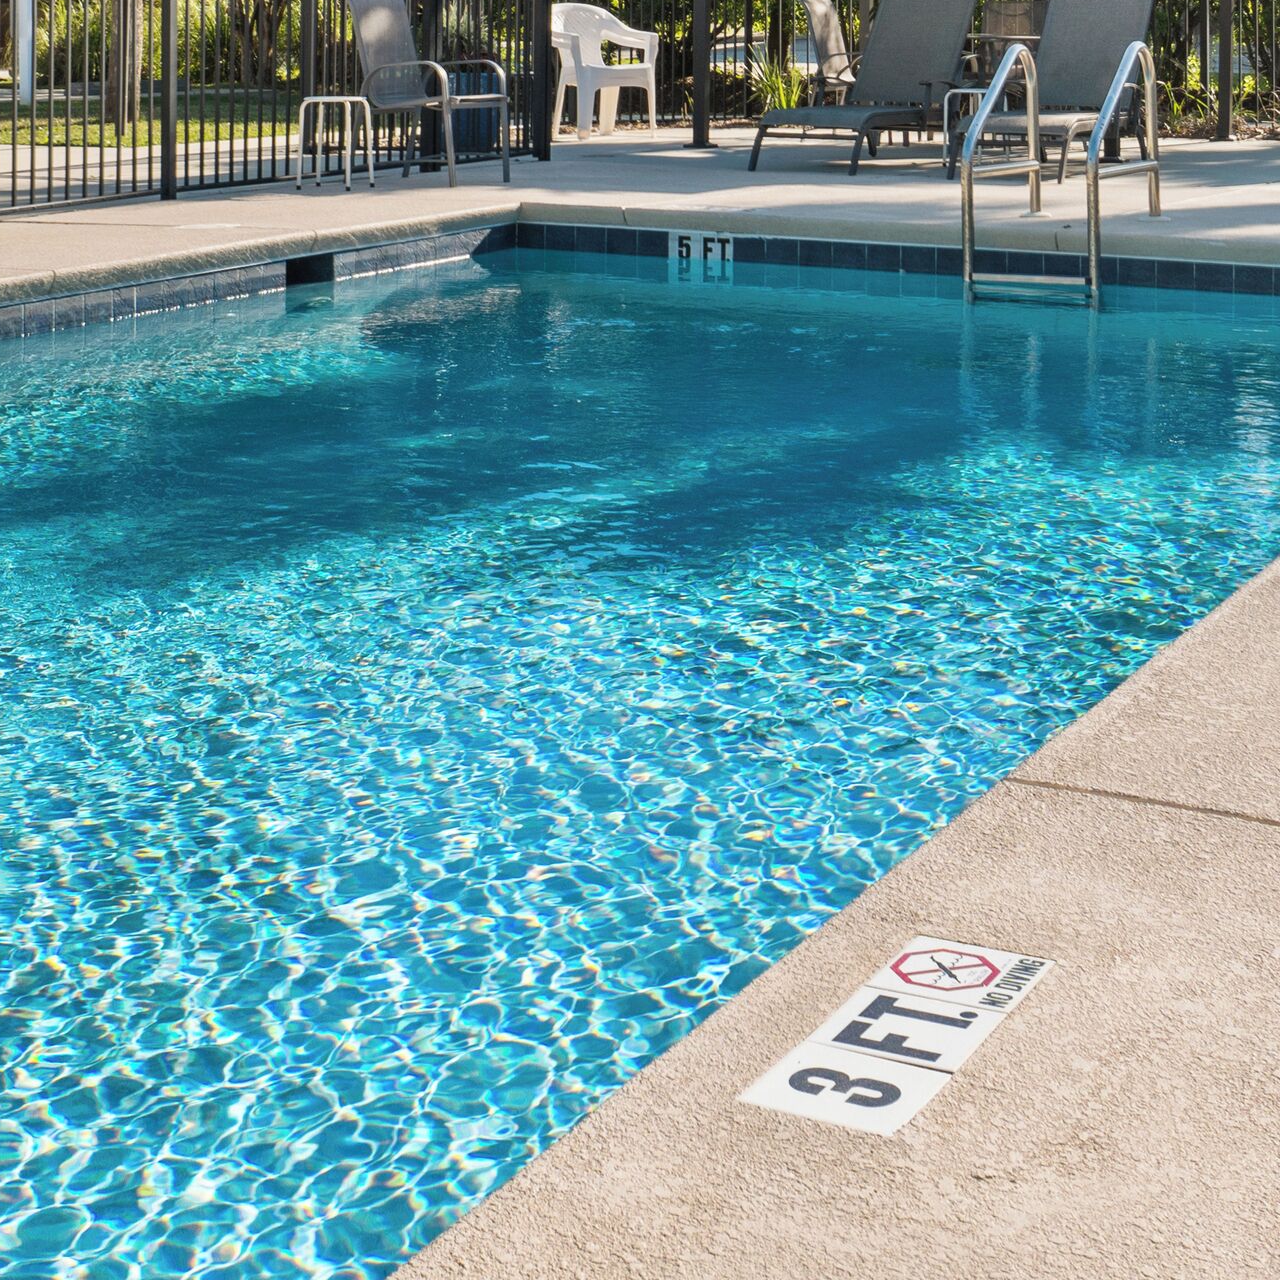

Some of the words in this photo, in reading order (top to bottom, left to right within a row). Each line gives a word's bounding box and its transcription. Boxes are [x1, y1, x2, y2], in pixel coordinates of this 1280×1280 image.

[678, 235, 691, 258] 5
[994, 958, 1046, 992] DIVING
[978, 991, 1013, 1009] NO
[831, 993, 979, 1063] FT.
[788, 1066, 902, 1108] 3
